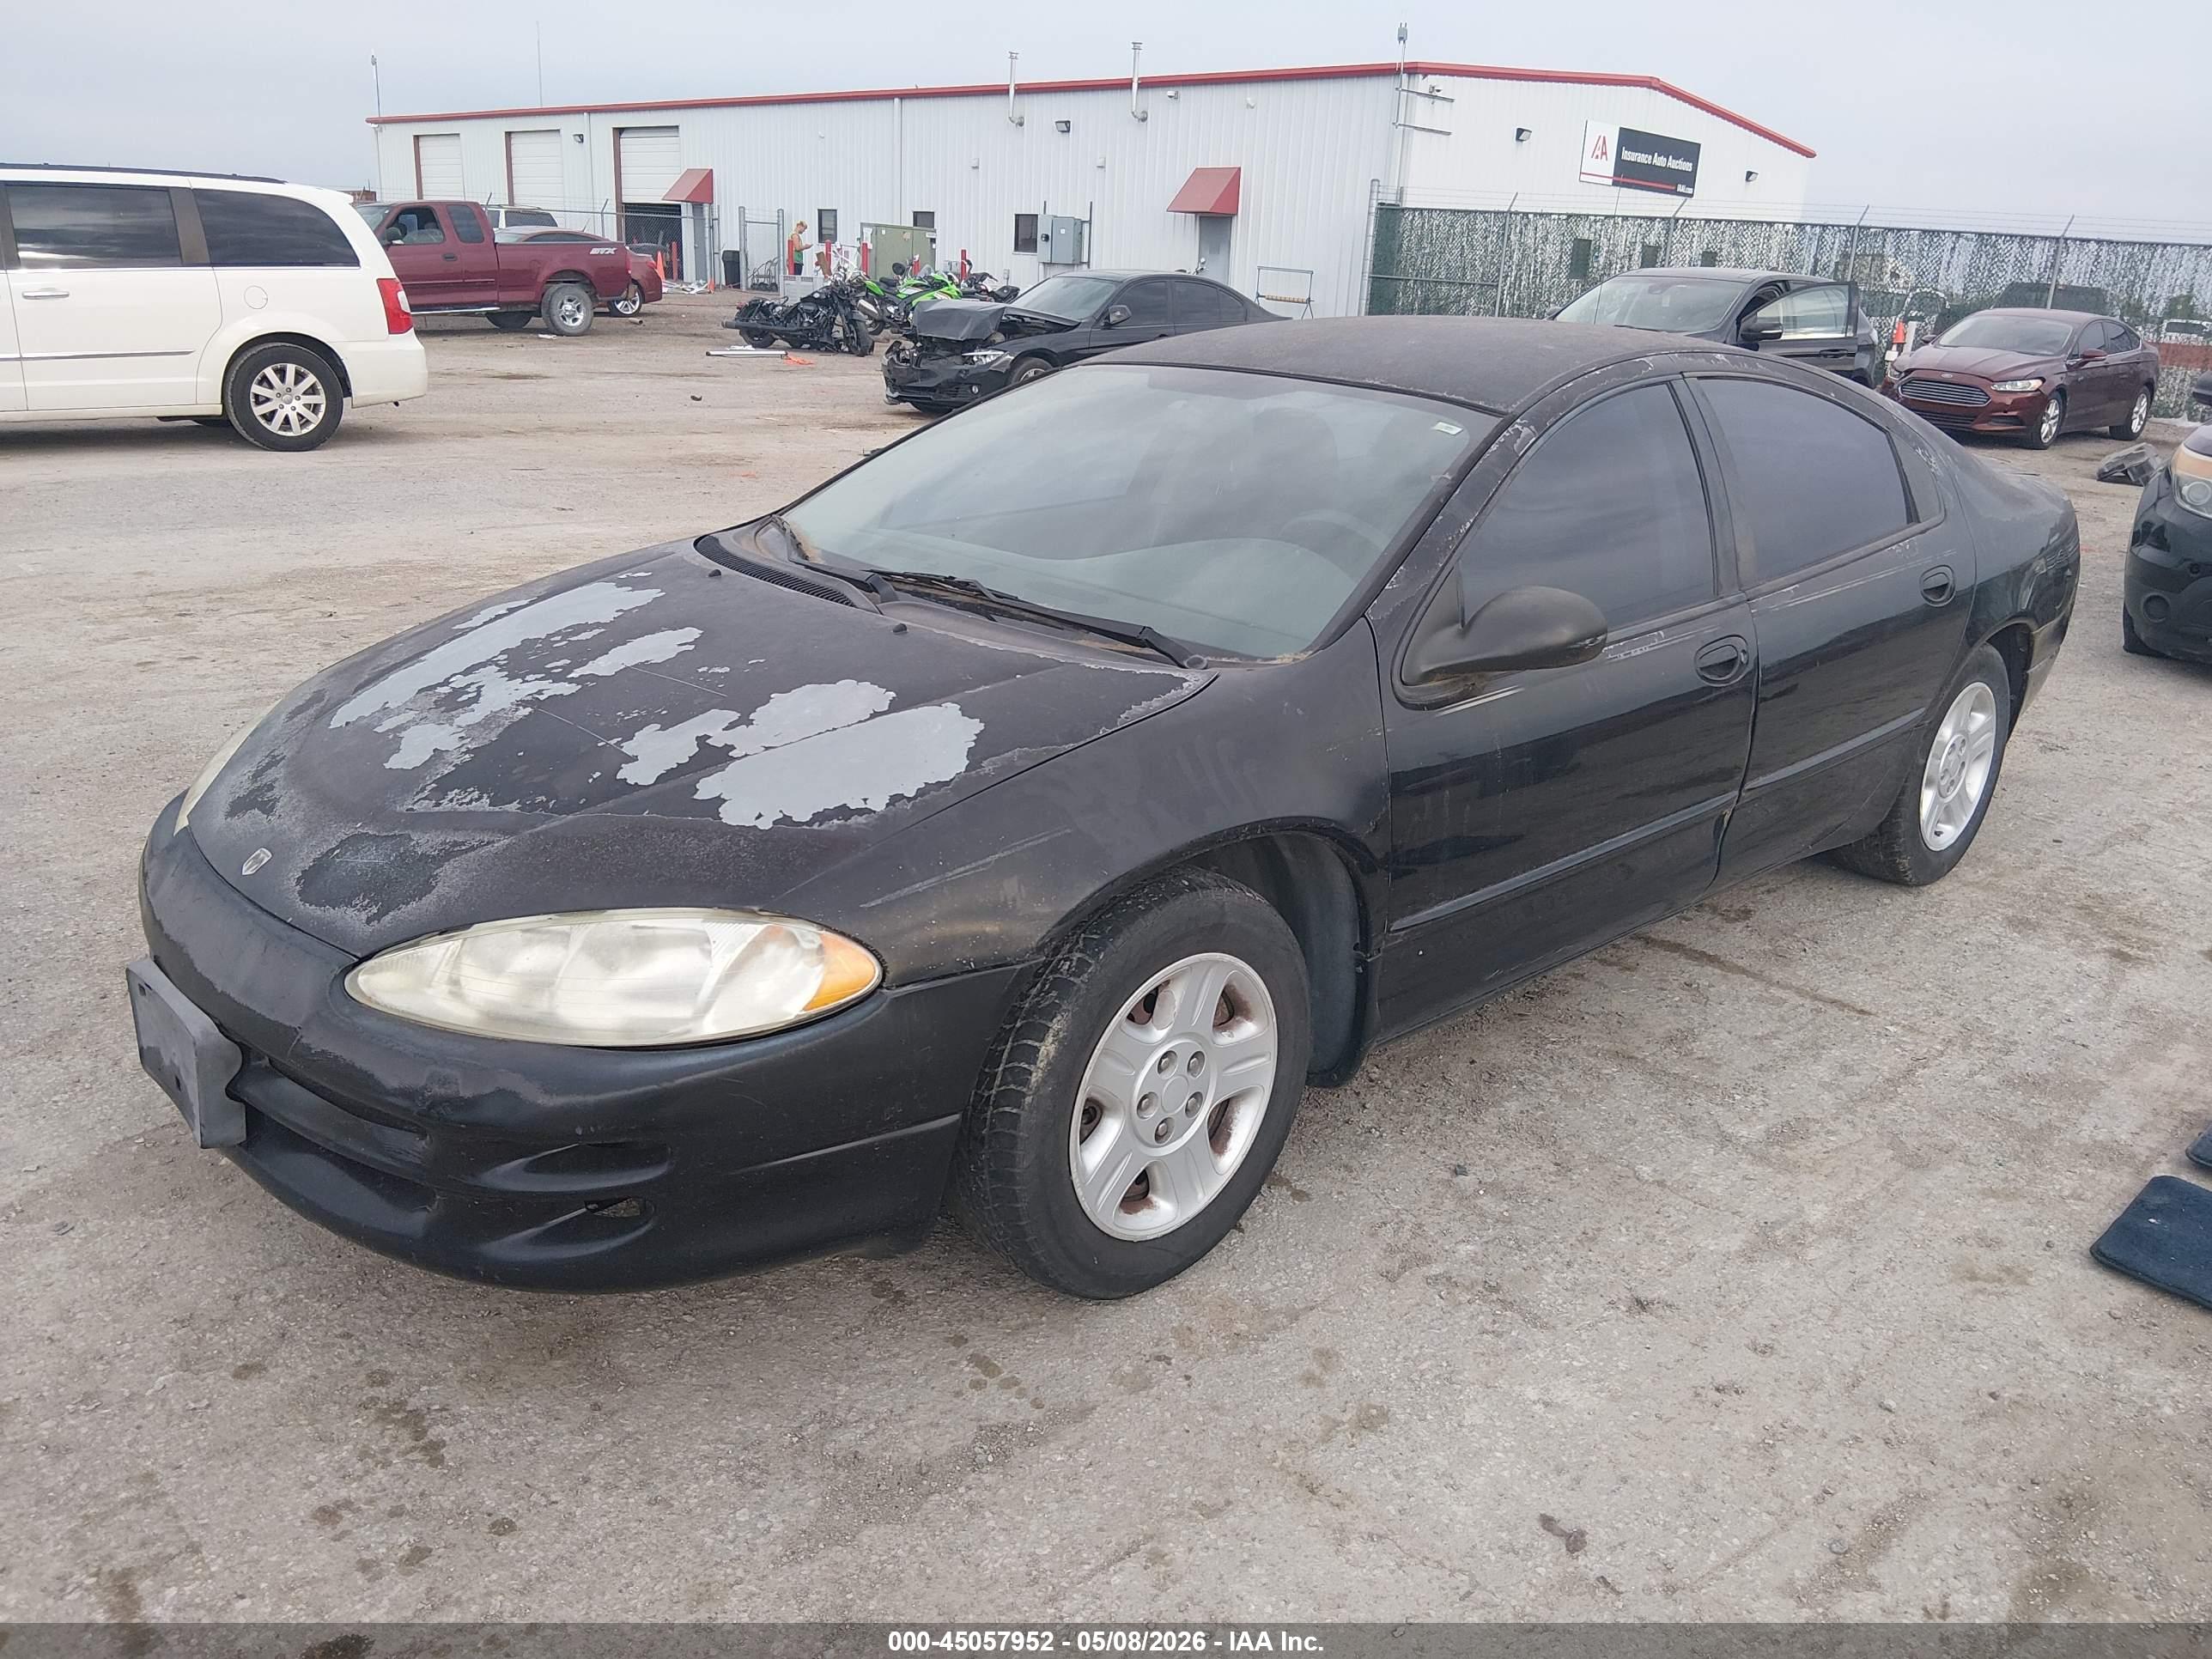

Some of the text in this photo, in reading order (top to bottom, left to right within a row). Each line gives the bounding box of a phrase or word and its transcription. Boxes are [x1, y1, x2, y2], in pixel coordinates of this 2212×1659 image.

[1621, 147, 1692, 172] Insurance Auto Auctions
